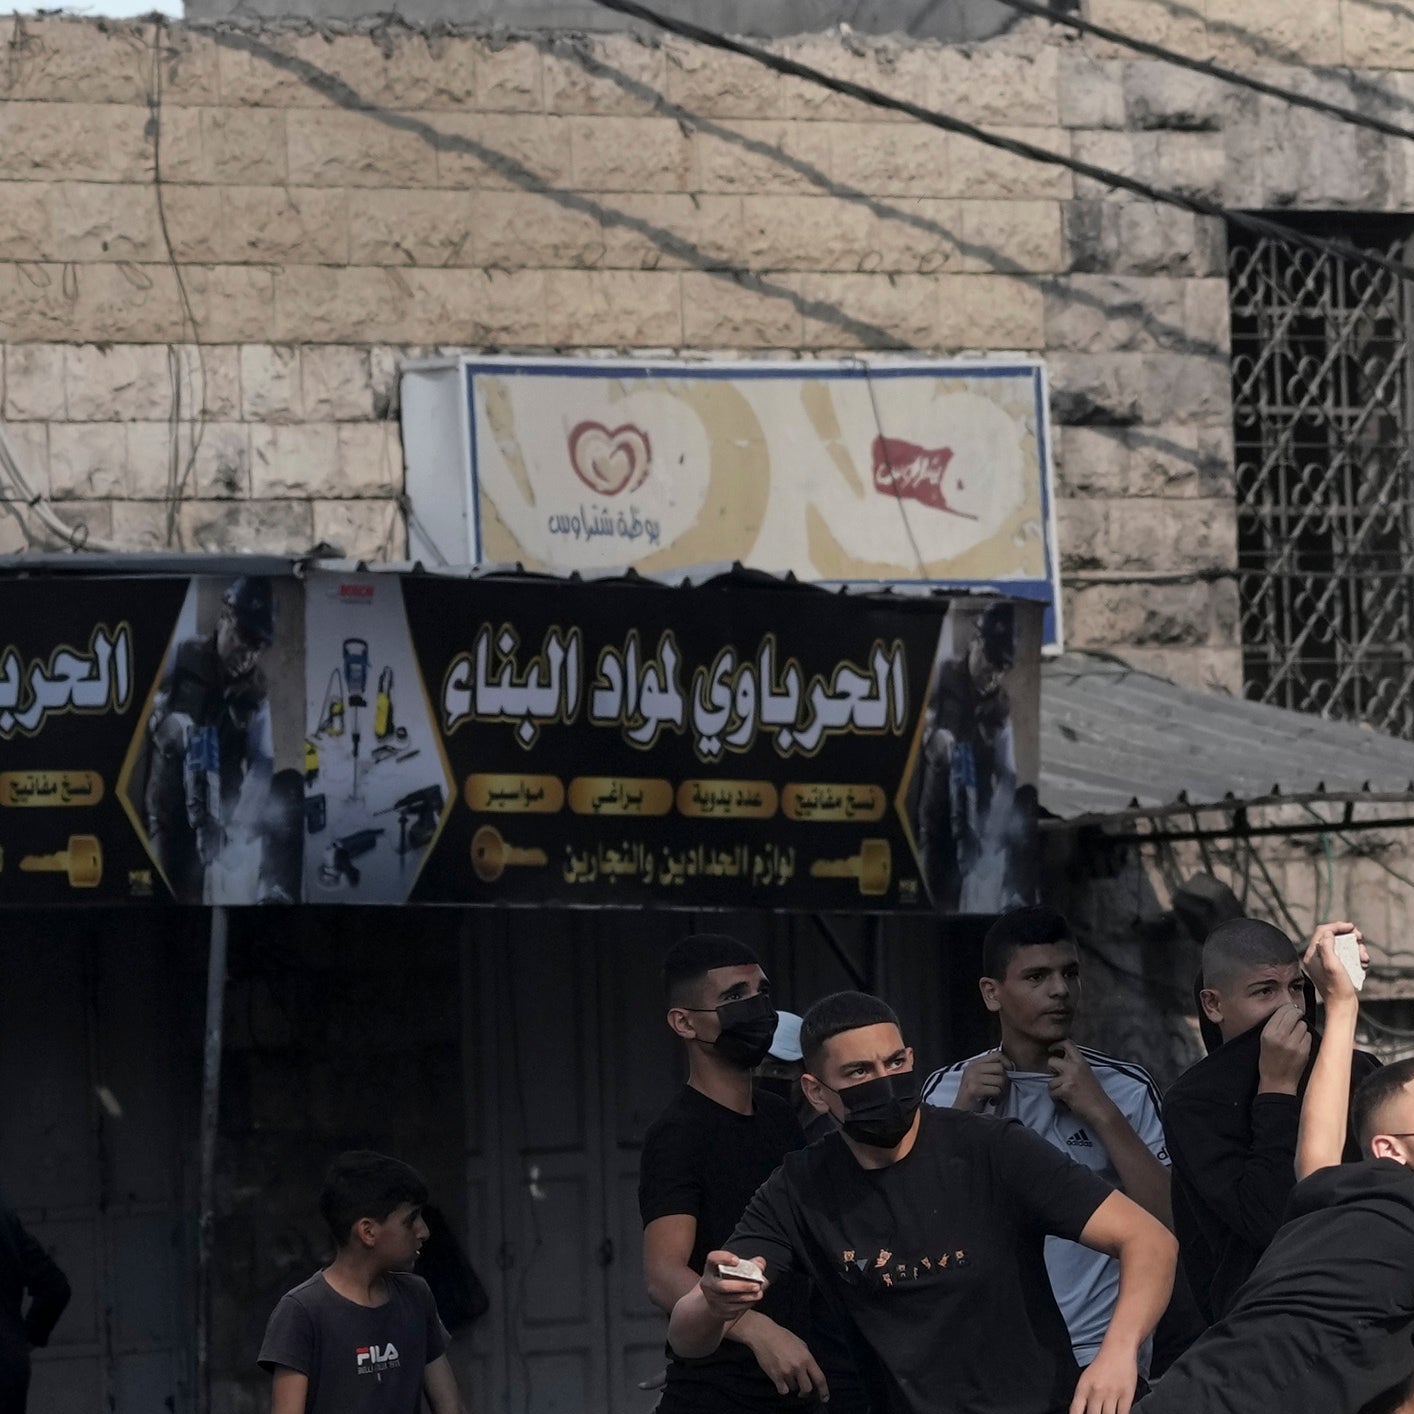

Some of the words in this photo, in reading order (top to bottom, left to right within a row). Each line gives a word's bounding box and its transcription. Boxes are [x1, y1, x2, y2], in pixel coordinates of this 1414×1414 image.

[548, 504, 614, 542] شتراوس
[617, 505, 661, 546] بوظة
[0, 621, 134, 739] الحرب
[443, 622, 582, 750] البناء
[589, 629, 687, 750] لمواد
[693, 632, 906, 762] الحرباوي
[563, 840, 654, 884] والنجارين
[751, 842, 795, 886] لوازم
[355, 1343, 399, 1366] FILA
